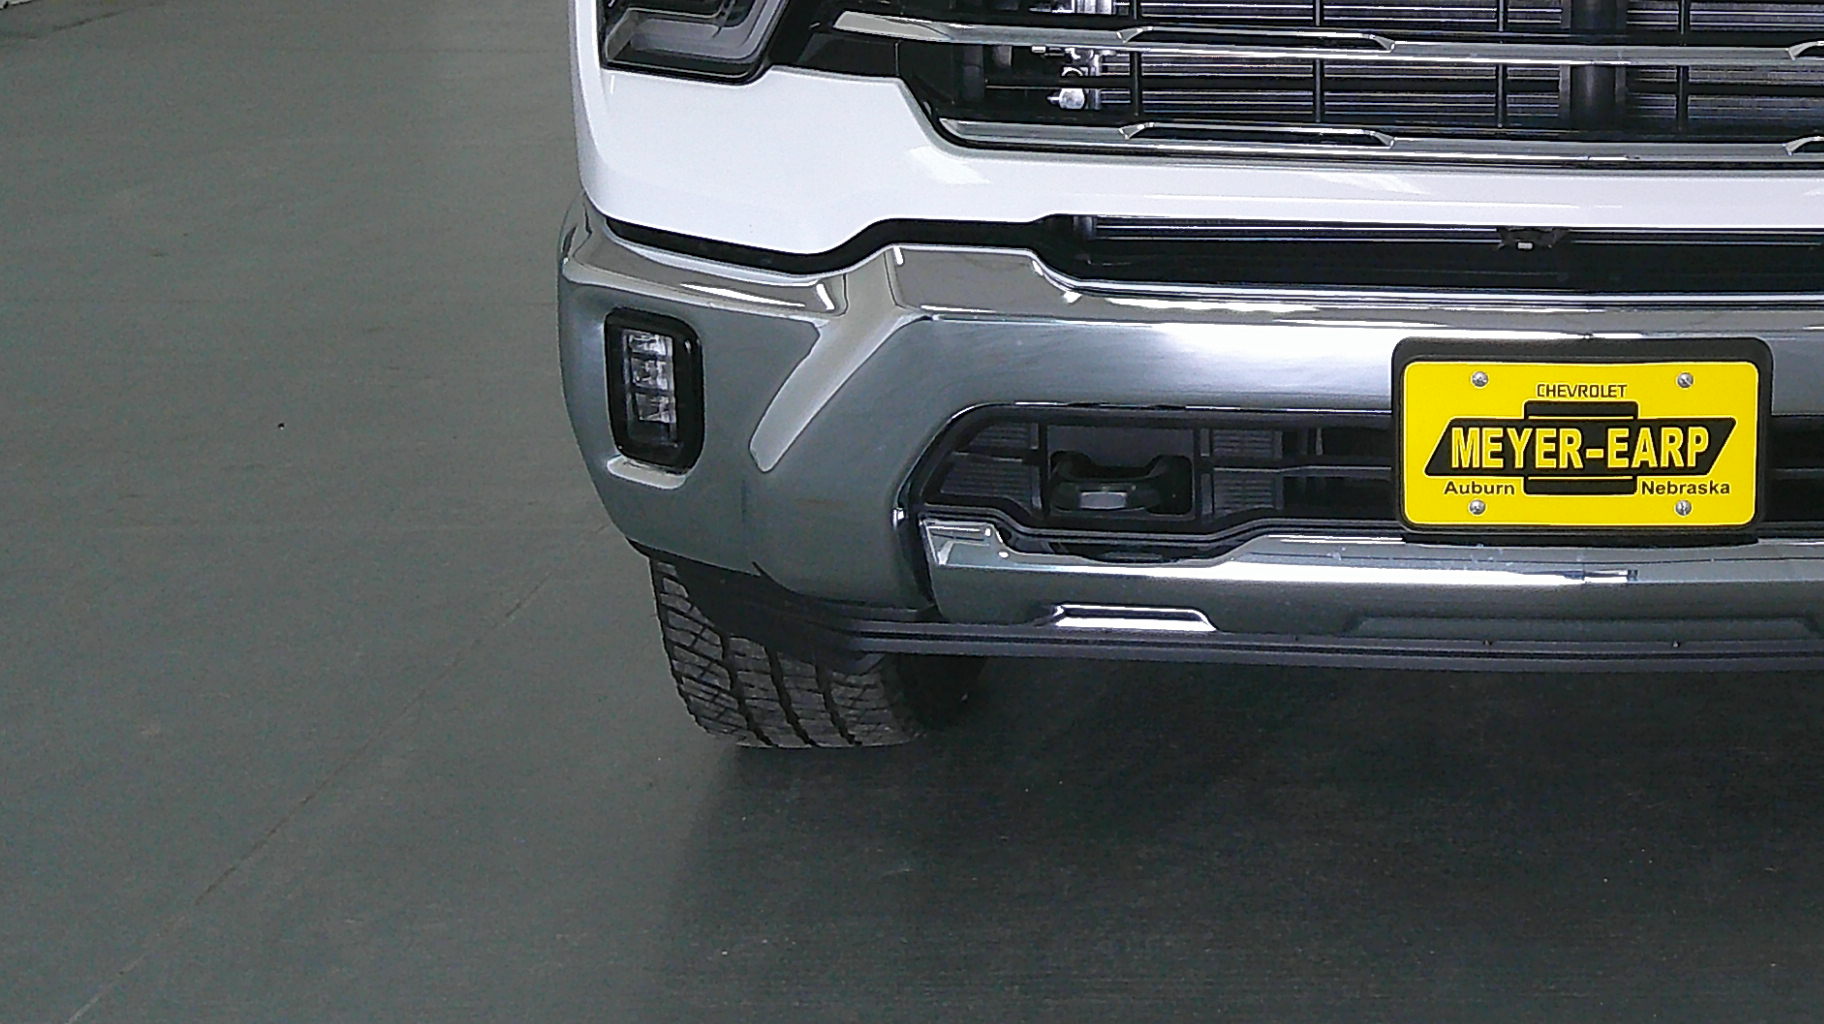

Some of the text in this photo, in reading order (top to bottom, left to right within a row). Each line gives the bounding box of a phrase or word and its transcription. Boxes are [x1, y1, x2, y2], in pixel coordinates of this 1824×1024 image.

[1536, 383, 1628, 398] CHEVROLET
[1450, 426, 1711, 470] MEYER-EARP
[1443, 480, 1731, 496] Auburn Nebraska
